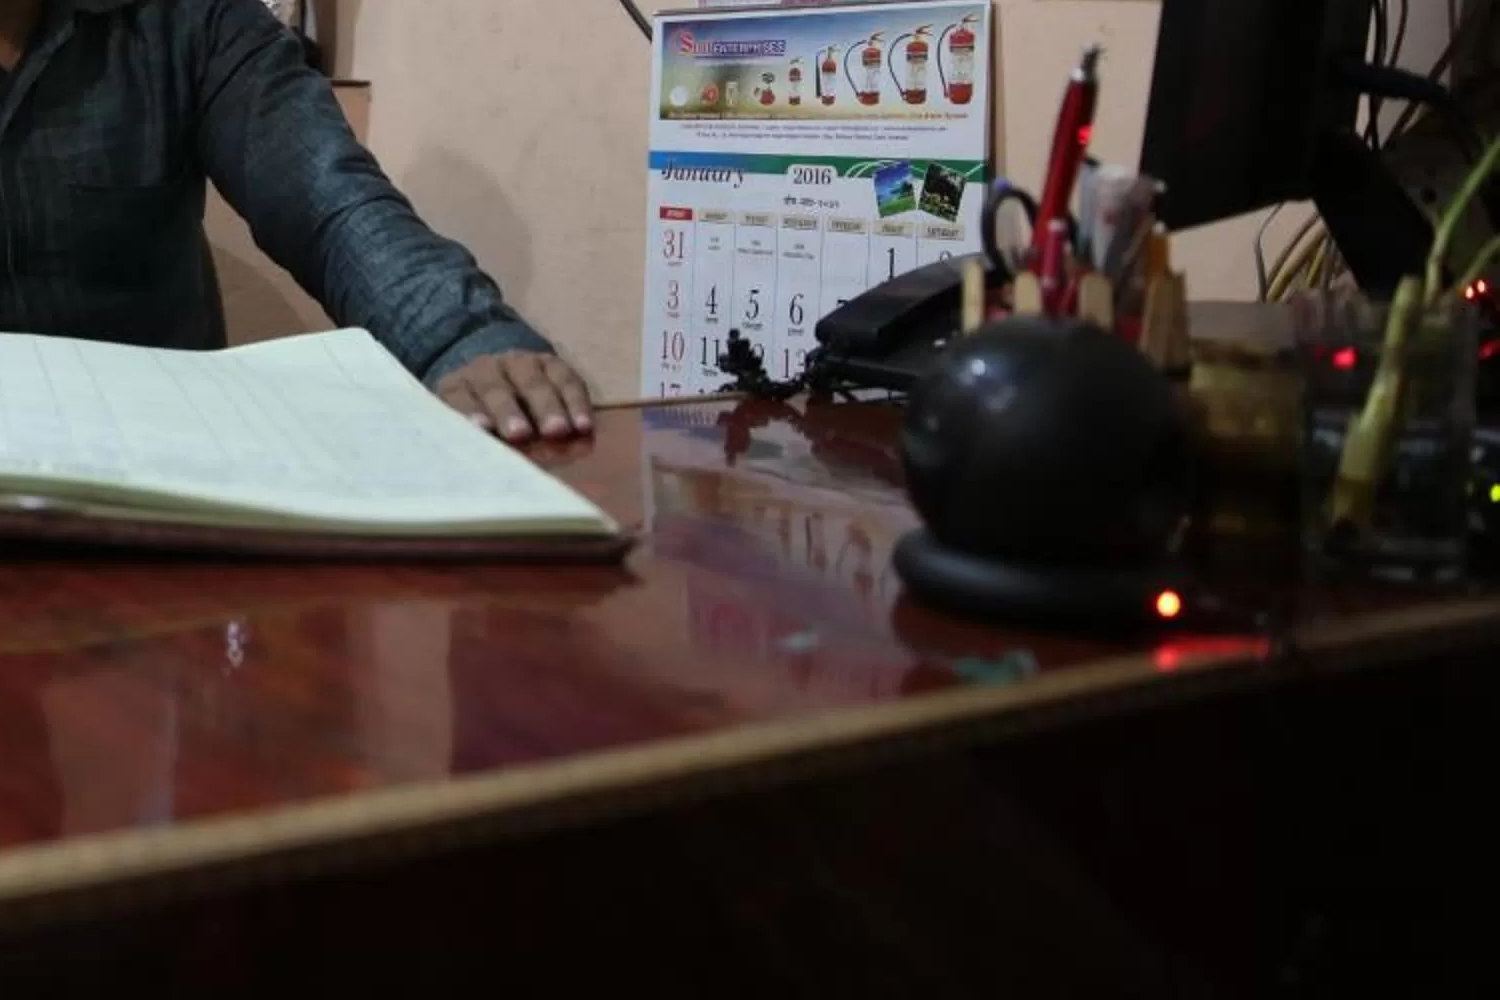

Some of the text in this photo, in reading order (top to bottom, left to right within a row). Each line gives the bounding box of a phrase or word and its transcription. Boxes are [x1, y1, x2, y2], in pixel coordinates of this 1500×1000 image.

[661, 159, 832, 189] January 2016
[663, 229, 685, 259] 31
[666, 280, 804, 326] 3 4 5 6
[662, 331, 685, 362] 10
